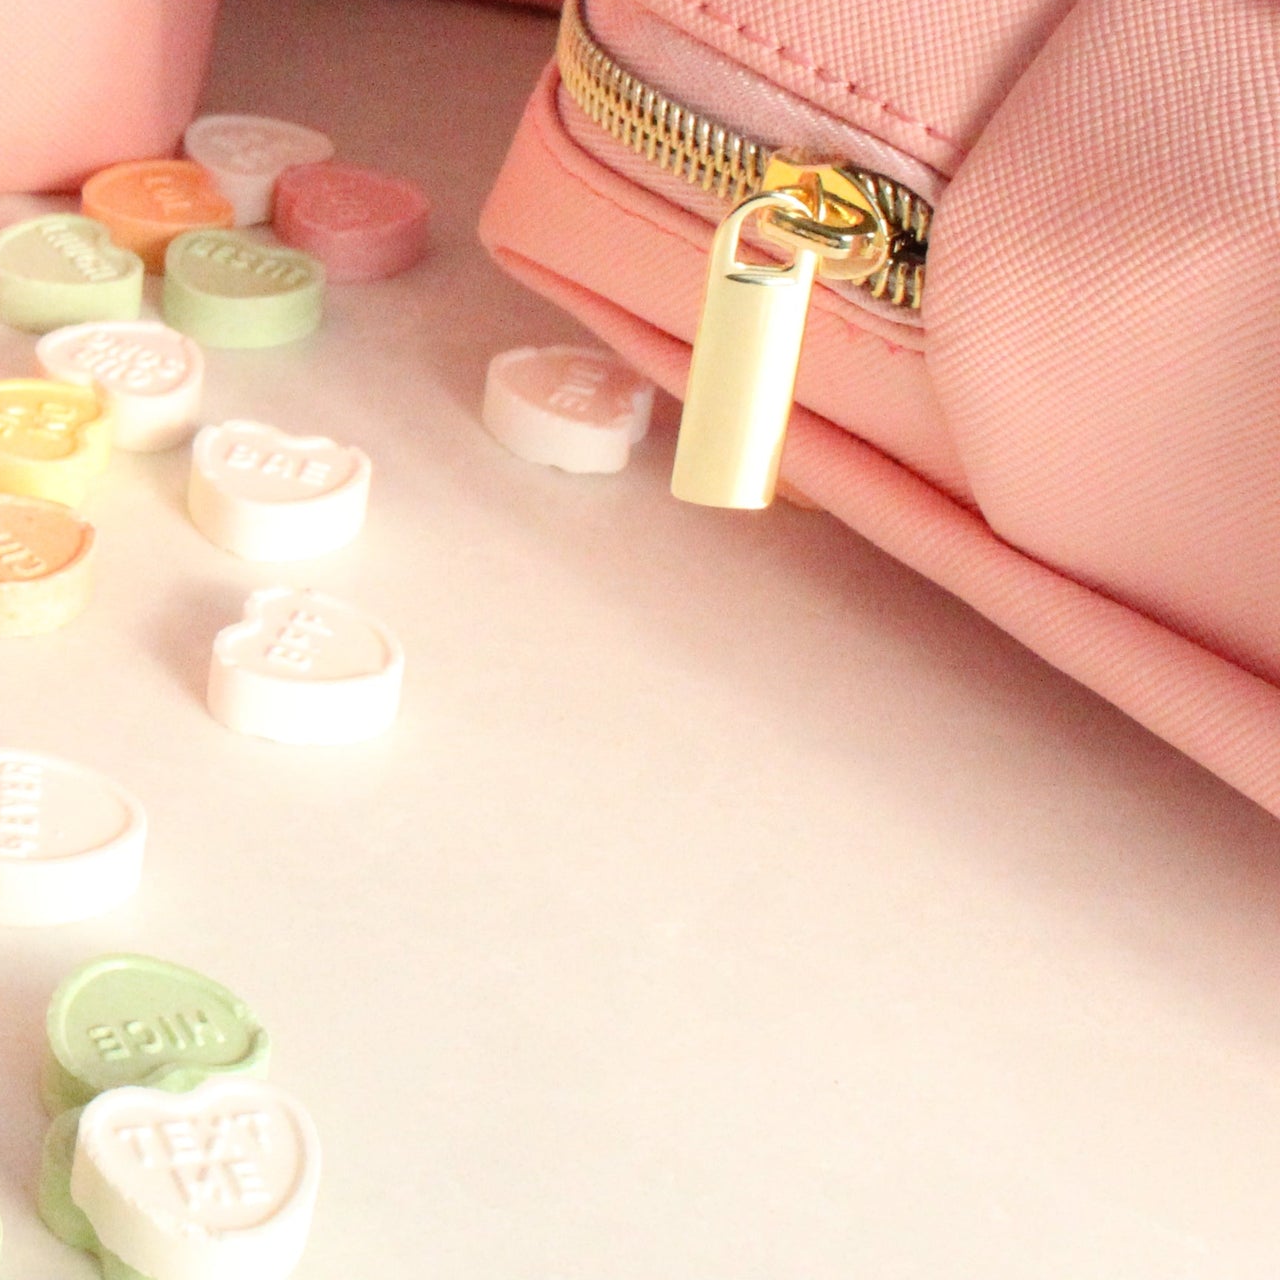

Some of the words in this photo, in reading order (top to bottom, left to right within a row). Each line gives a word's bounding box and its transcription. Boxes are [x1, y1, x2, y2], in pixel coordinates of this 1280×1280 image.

[226, 442, 331, 488] BAE
[264, 610, 334, 671] BFF
[88, 1010, 228, 1061] NICE
[116, 1111, 270, 1165] TEXT
[177, 1160, 271, 1209] ME
